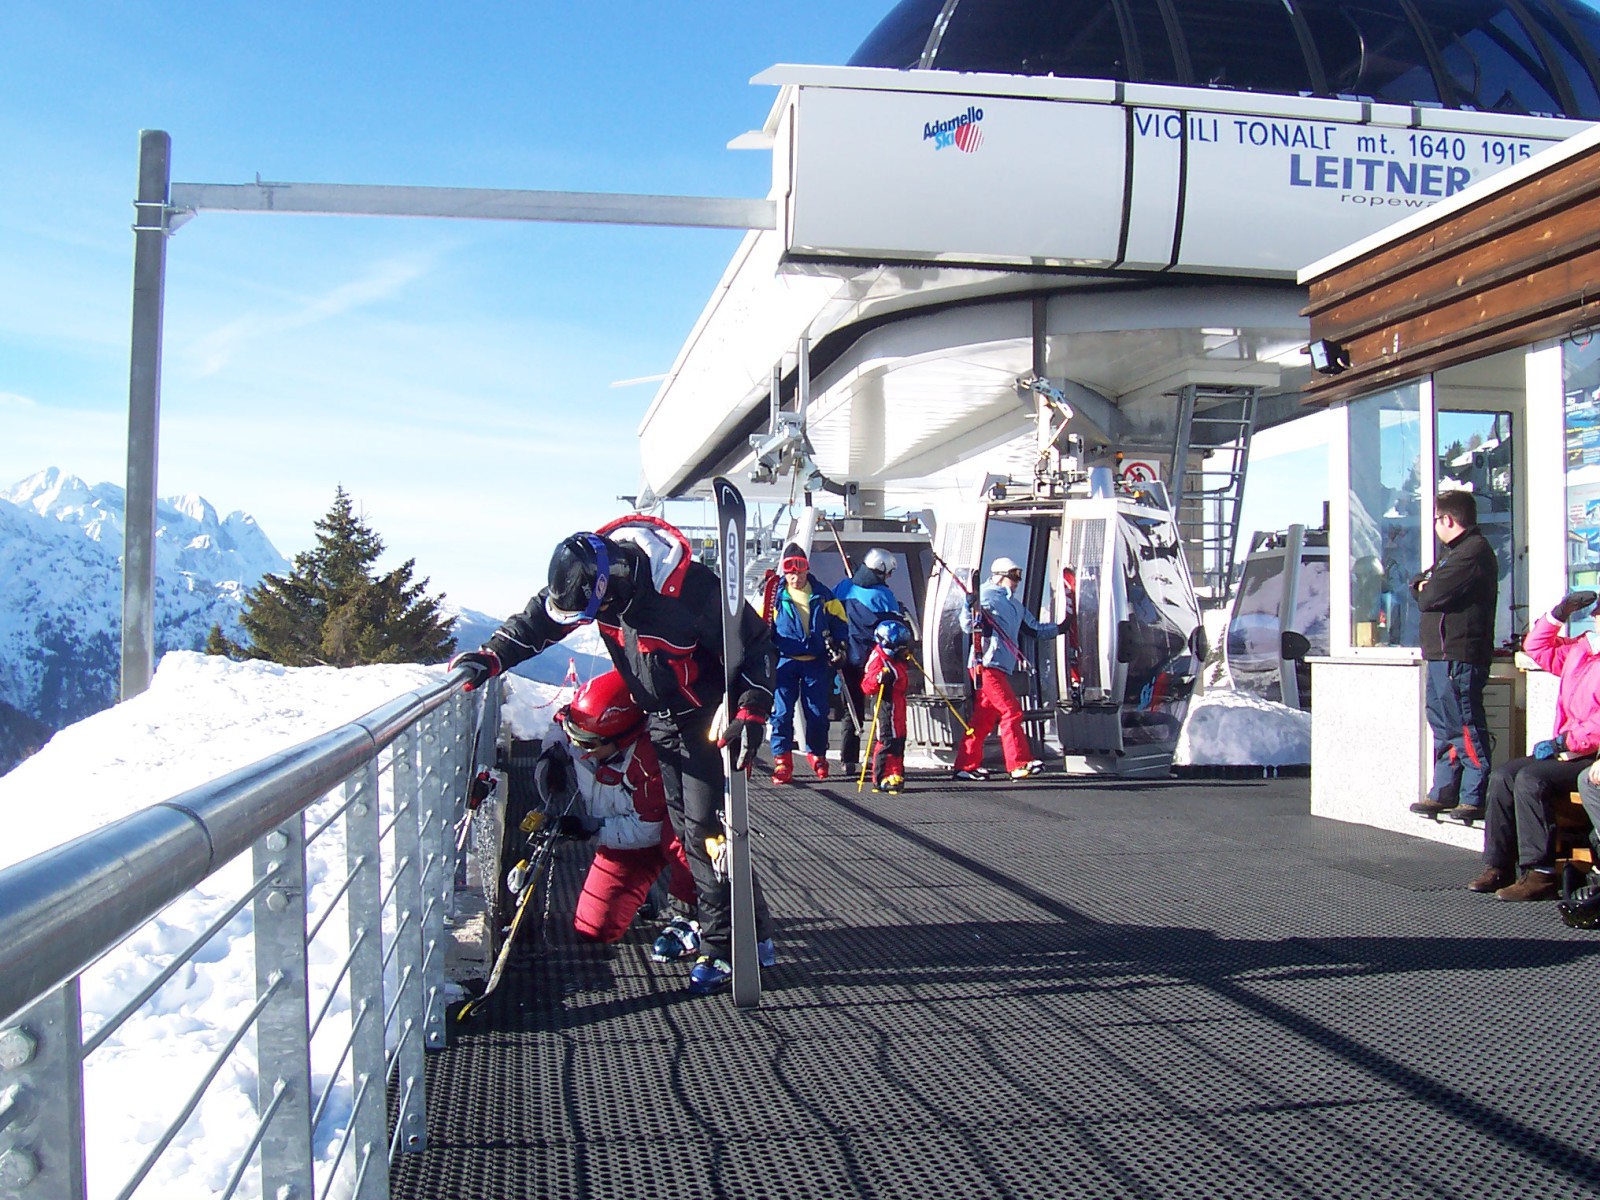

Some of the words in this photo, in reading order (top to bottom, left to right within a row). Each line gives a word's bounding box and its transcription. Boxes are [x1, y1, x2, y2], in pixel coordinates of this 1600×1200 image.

[923, 106, 983, 141] Adamello
[935, 131, 955, 151] Ski
[1357, 133, 1396, 155] mt.
[1409, 134, 1466, 161] 1640
[1481, 141, 1532, 166] 1915
[1290, 154, 1471, 197] LEITNER
[728, 532, 737, 600] HEAD
